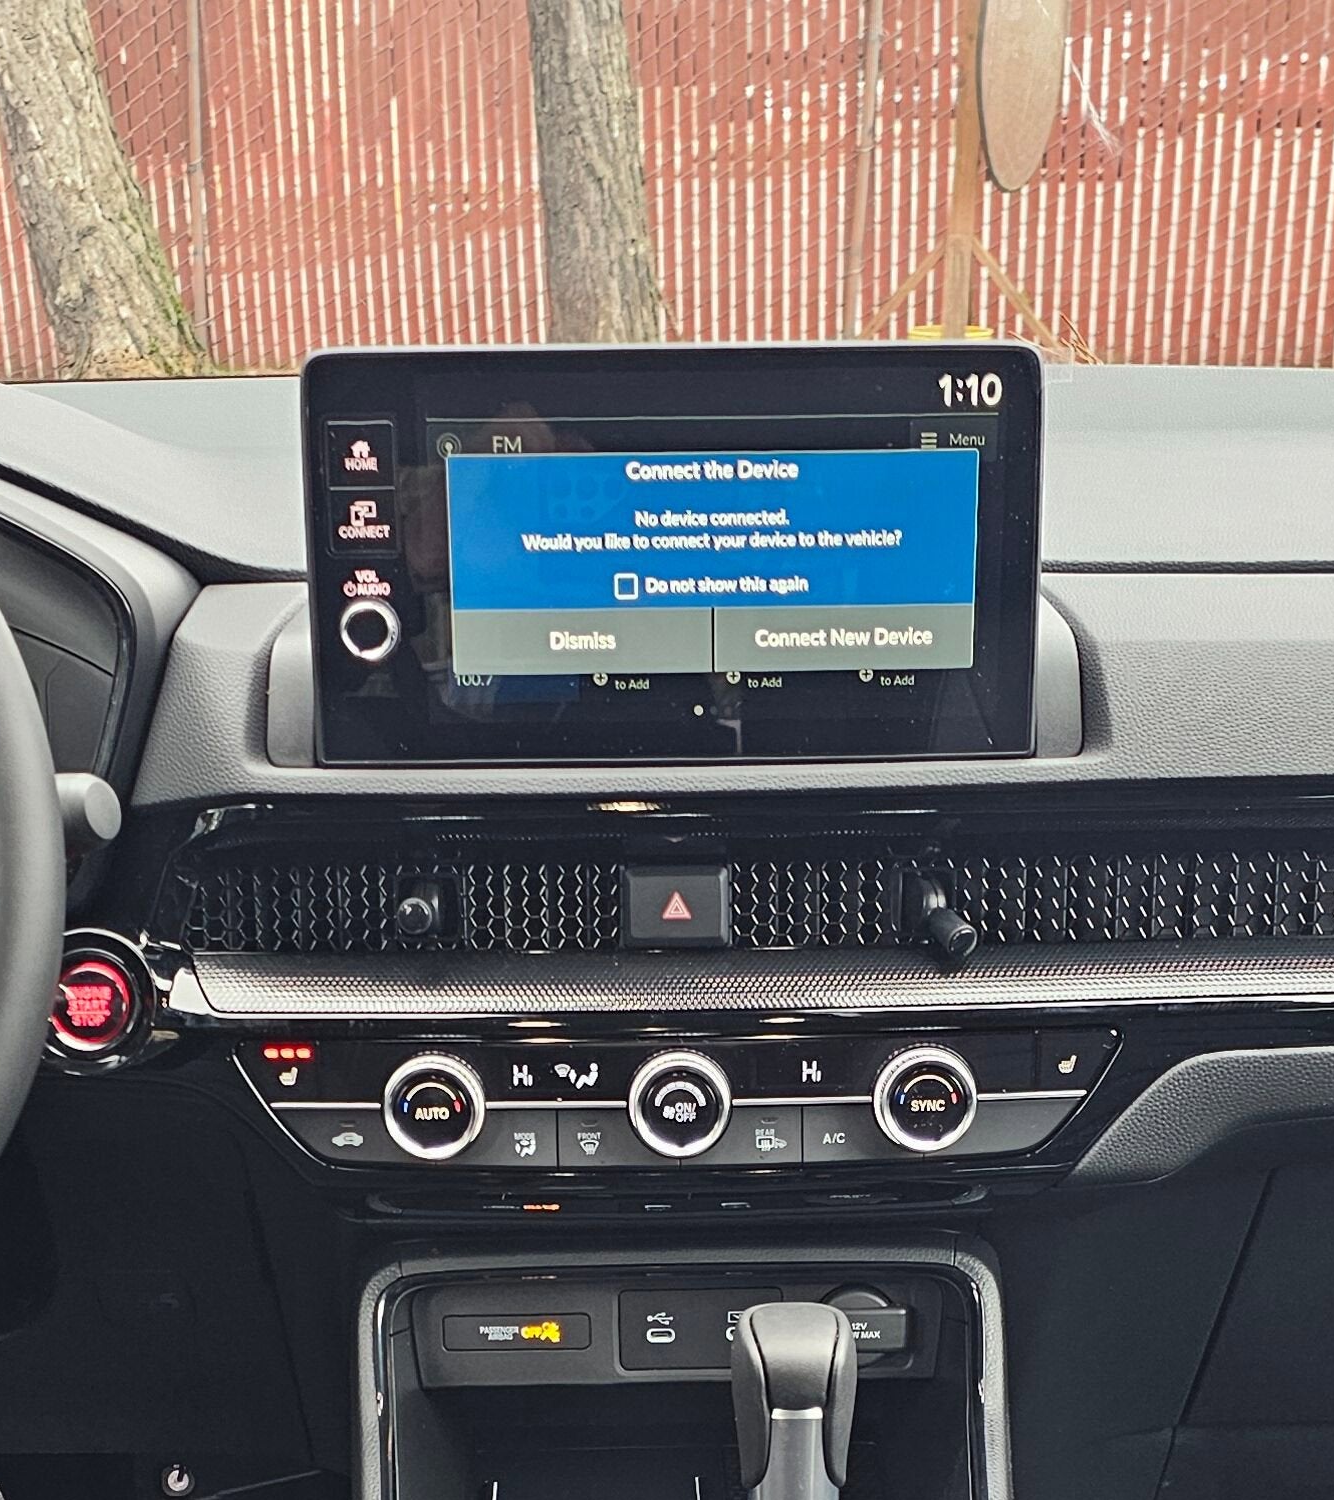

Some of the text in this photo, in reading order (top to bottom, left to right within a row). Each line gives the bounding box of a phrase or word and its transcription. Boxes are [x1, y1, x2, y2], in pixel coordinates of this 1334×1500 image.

[938, 372, 1003, 407] 1:10
[492, 436, 522, 453] FM
[949, 433, 985, 446] Menu
[344, 457, 378, 472] HOME
[625, 458, 799, 480] Connect the Device
[635, 508, 790, 527] No device connected.
[338, 525, 390, 539] CONNECT
[521, 529, 903, 552] Would you like to connect your device to the vehicle?
[355, 570, 379, 583] VOL
[358, 582, 391, 596] AUDIO
[645, 575, 809, 594] Do not show this again
[550, 631, 616, 650] Dismiss
[755, 626, 933, 647] Connect New Device
[615, 679, 650, 690] to Add
[748, 677, 782, 688] to Add
[880, 675, 915, 686] to Add
[910, 1099, 946, 1113] SYNC
[414, 1107, 450, 1121] AUTO
[675, 1111, 697, 1123] OFF
[577, 1132, 602, 1140] FRONT
[755, 1129, 775, 1137] REAR
[822, 1132, 846, 1145] A/C
[860, 1331, 881, 1339] MAX
